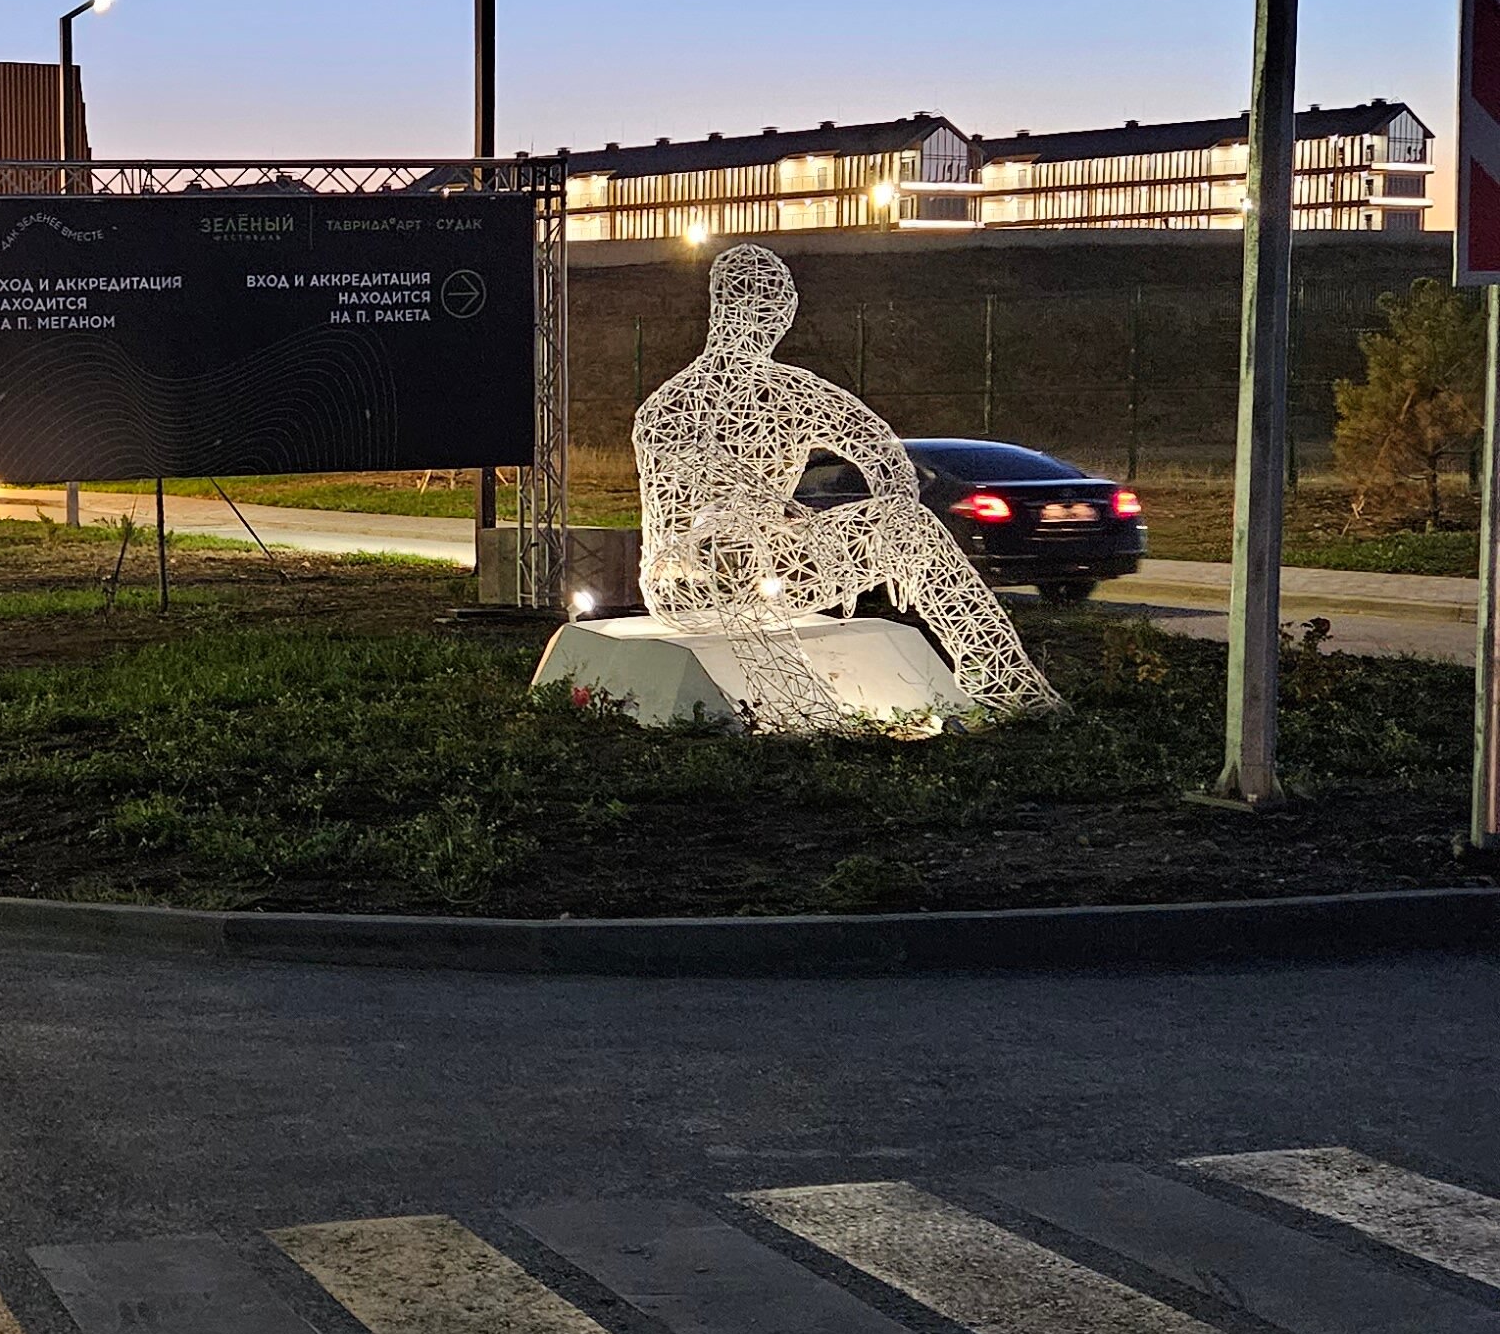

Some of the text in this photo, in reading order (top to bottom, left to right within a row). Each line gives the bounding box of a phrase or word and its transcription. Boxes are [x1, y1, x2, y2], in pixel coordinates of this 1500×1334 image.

[200, 214, 294, 233] ЗЕЛЁНЫЙ
[326, 218, 483, 231] ТАВРИДА АРТ СУДАК
[61, 226, 104, 242] ВМЕСТЕ
[39, 278, 49, 292] И
[55, 276, 182, 292] АККРЕДИТАЦИЯ
[247, 272, 431, 289] ВХОД И АККРЕДИТАЦИЯ
[338, 291, 431, 305] НАХОДИТСЯ
[17, 317, 32, 330] П.
[37, 316, 116, 330] МЕГАНОМ
[330, 309, 431, 324] НА П. РАКЕТА
